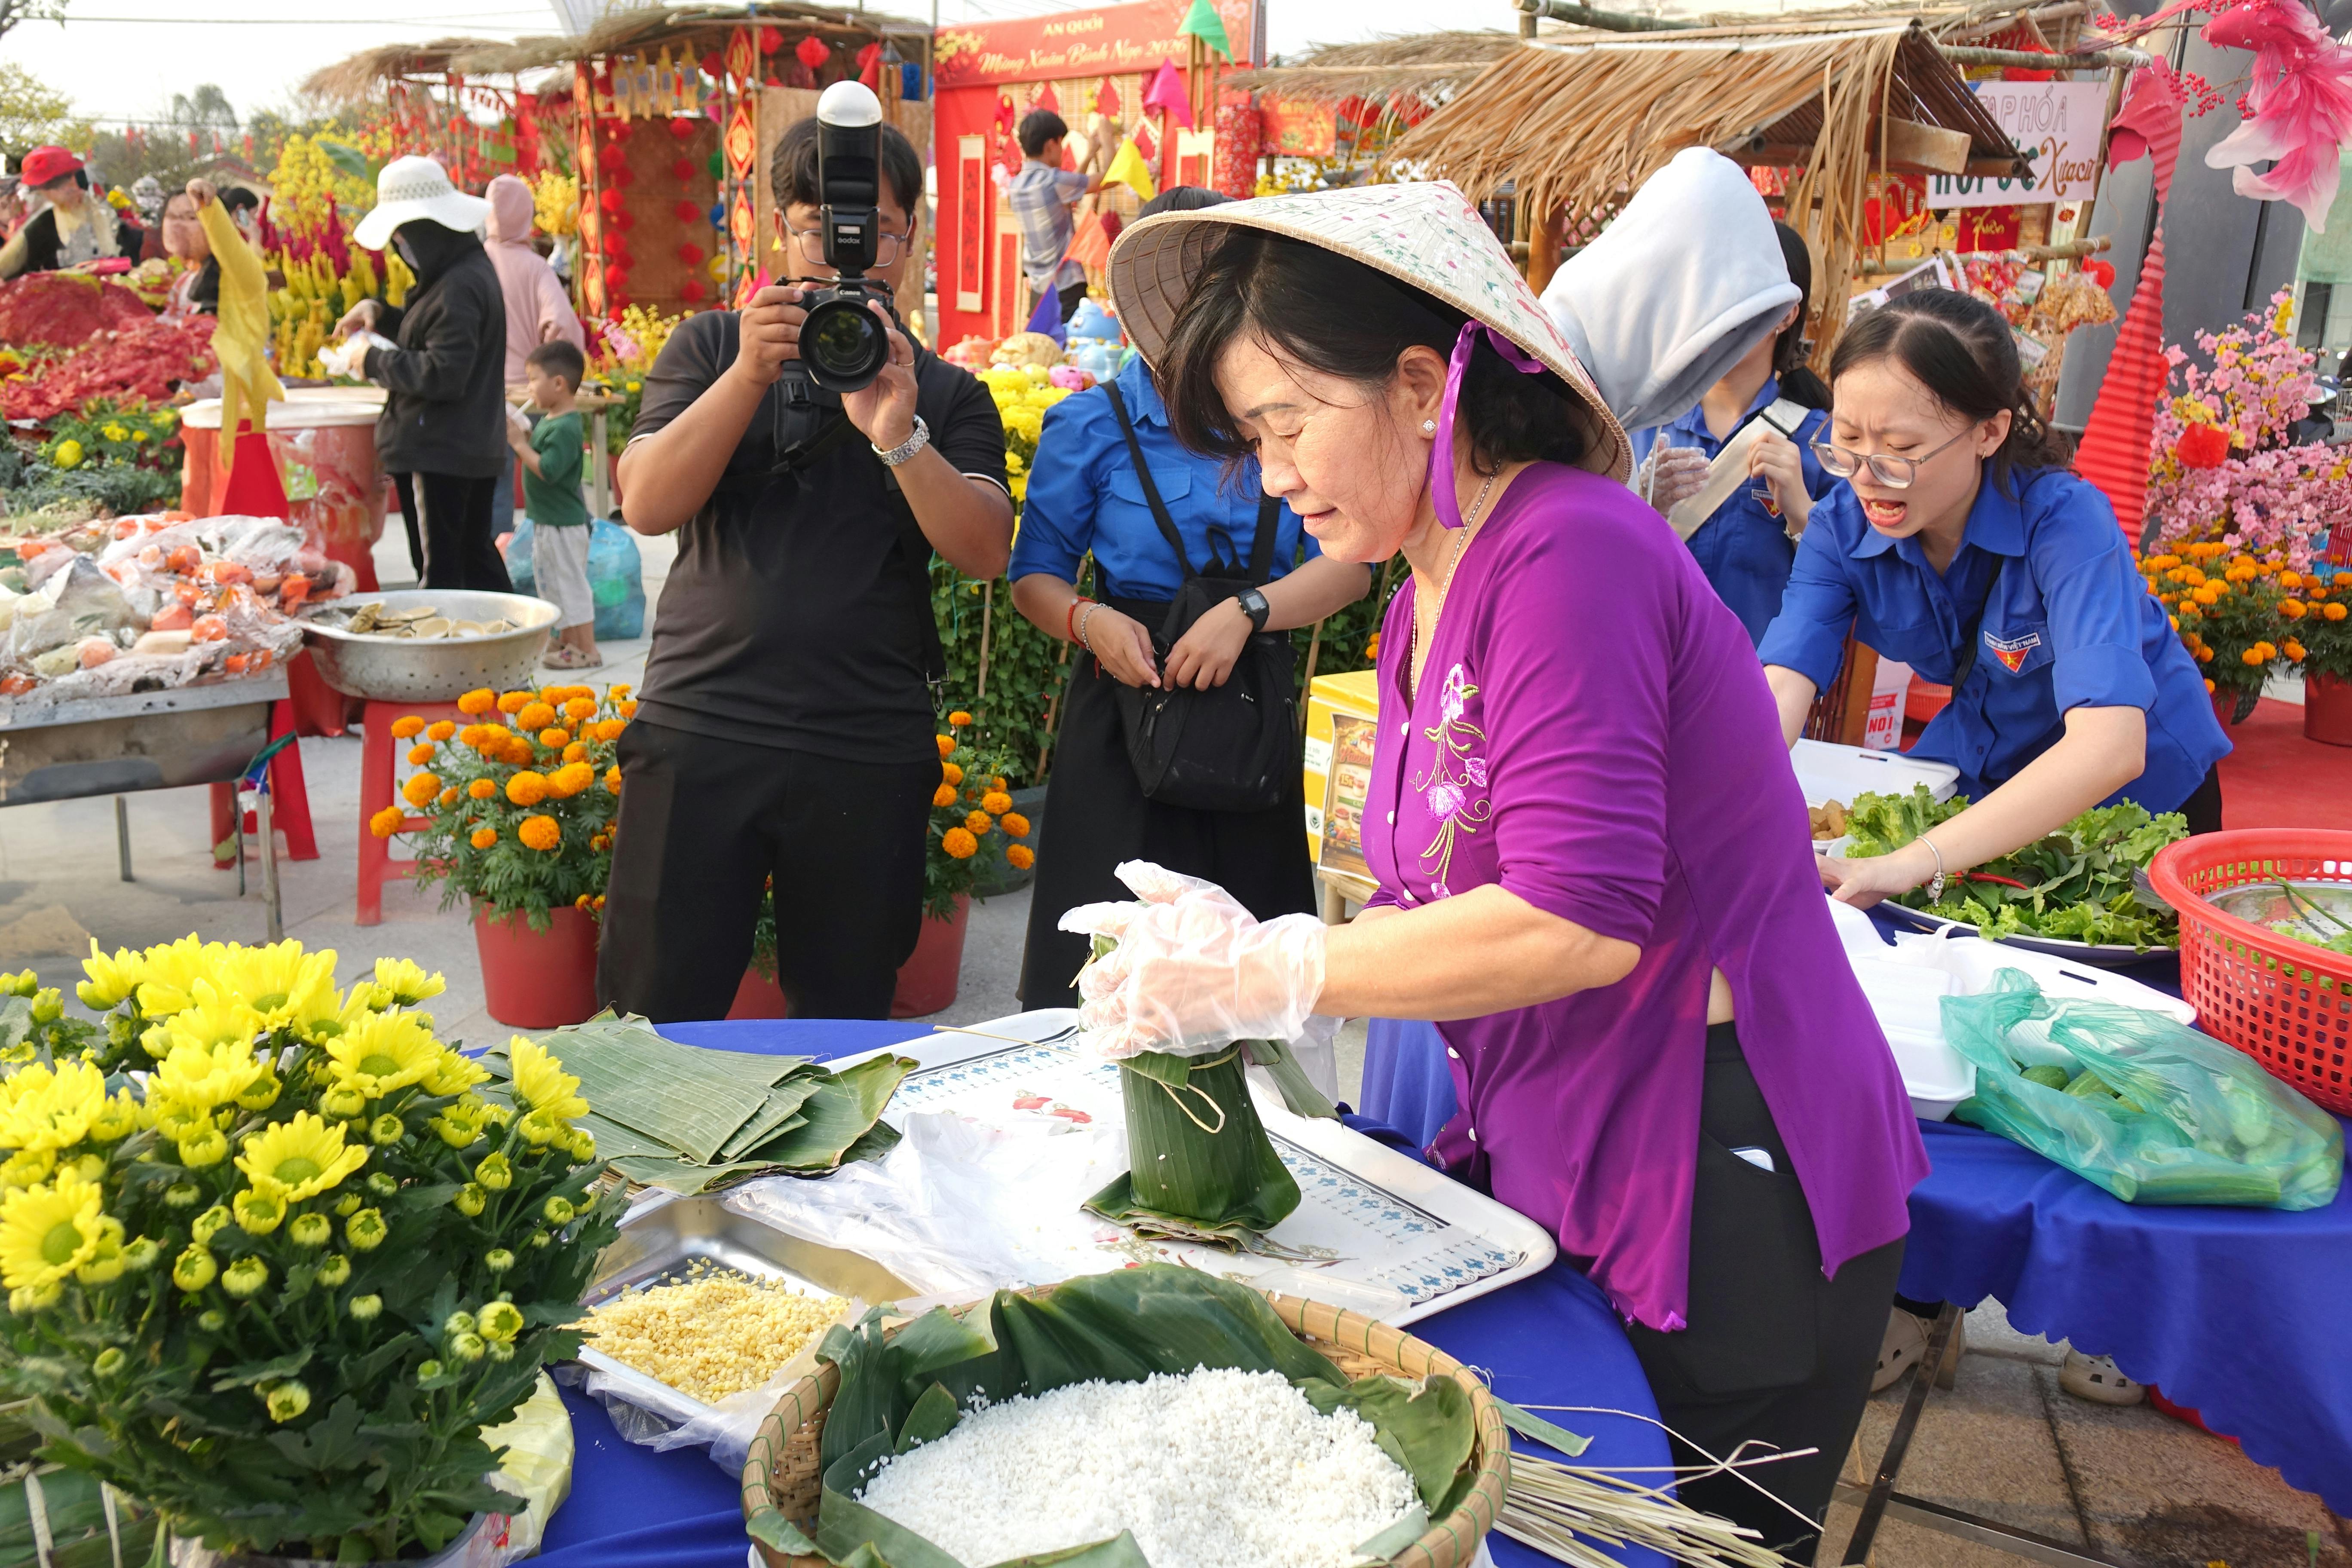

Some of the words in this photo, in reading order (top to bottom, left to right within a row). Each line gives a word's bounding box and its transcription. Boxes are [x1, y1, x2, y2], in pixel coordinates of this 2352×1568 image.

[1043, 22, 1064, 37] AN
[1145, 37, 1187, 58] 2026
[2018, 84, 2067, 132] HÓA
[2008, 641, 2022, 651] VIỆT
[2023, 637, 2037, 646] NAM
